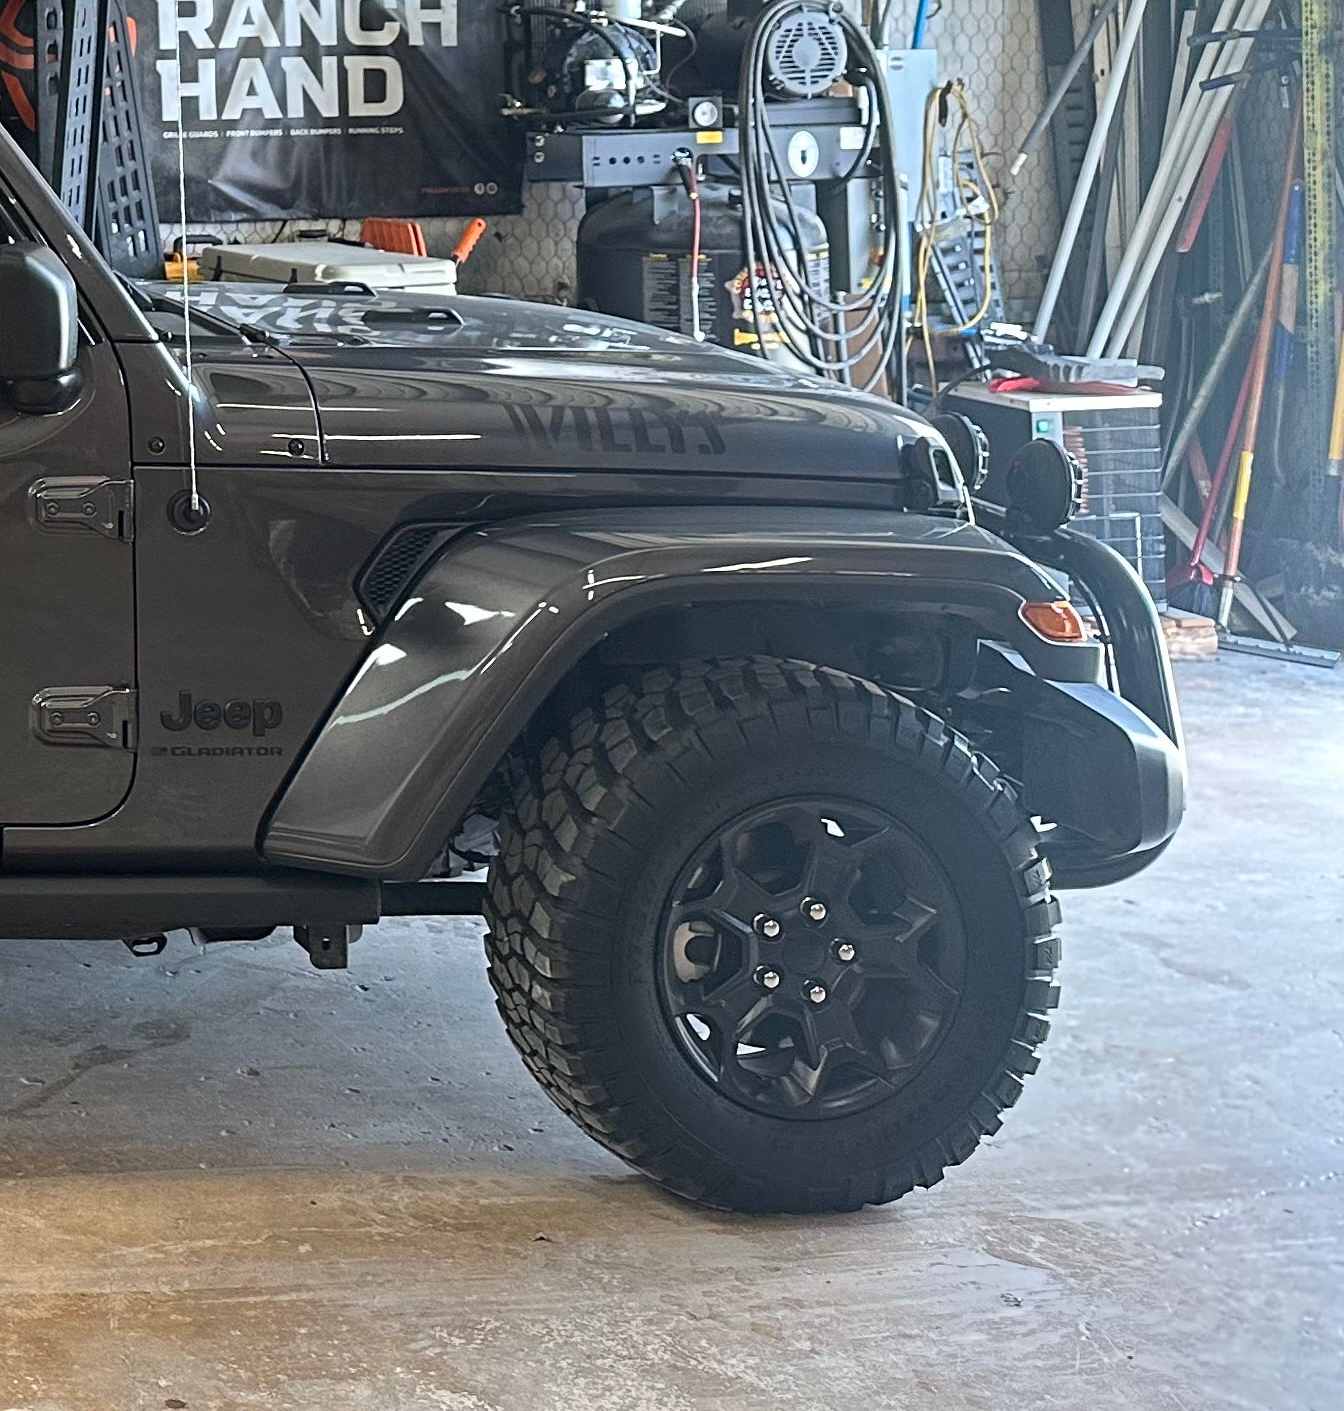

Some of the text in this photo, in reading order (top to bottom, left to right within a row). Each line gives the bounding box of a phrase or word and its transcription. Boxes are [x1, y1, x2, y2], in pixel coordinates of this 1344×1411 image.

[156, 55, 405, 122] HAND
[162, 131, 188, 139] GRILE
[502, 404, 726, 455] WILLYS
[160, 690, 283, 737] Jeep
[171, 747, 283, 756] GLADIATOR
